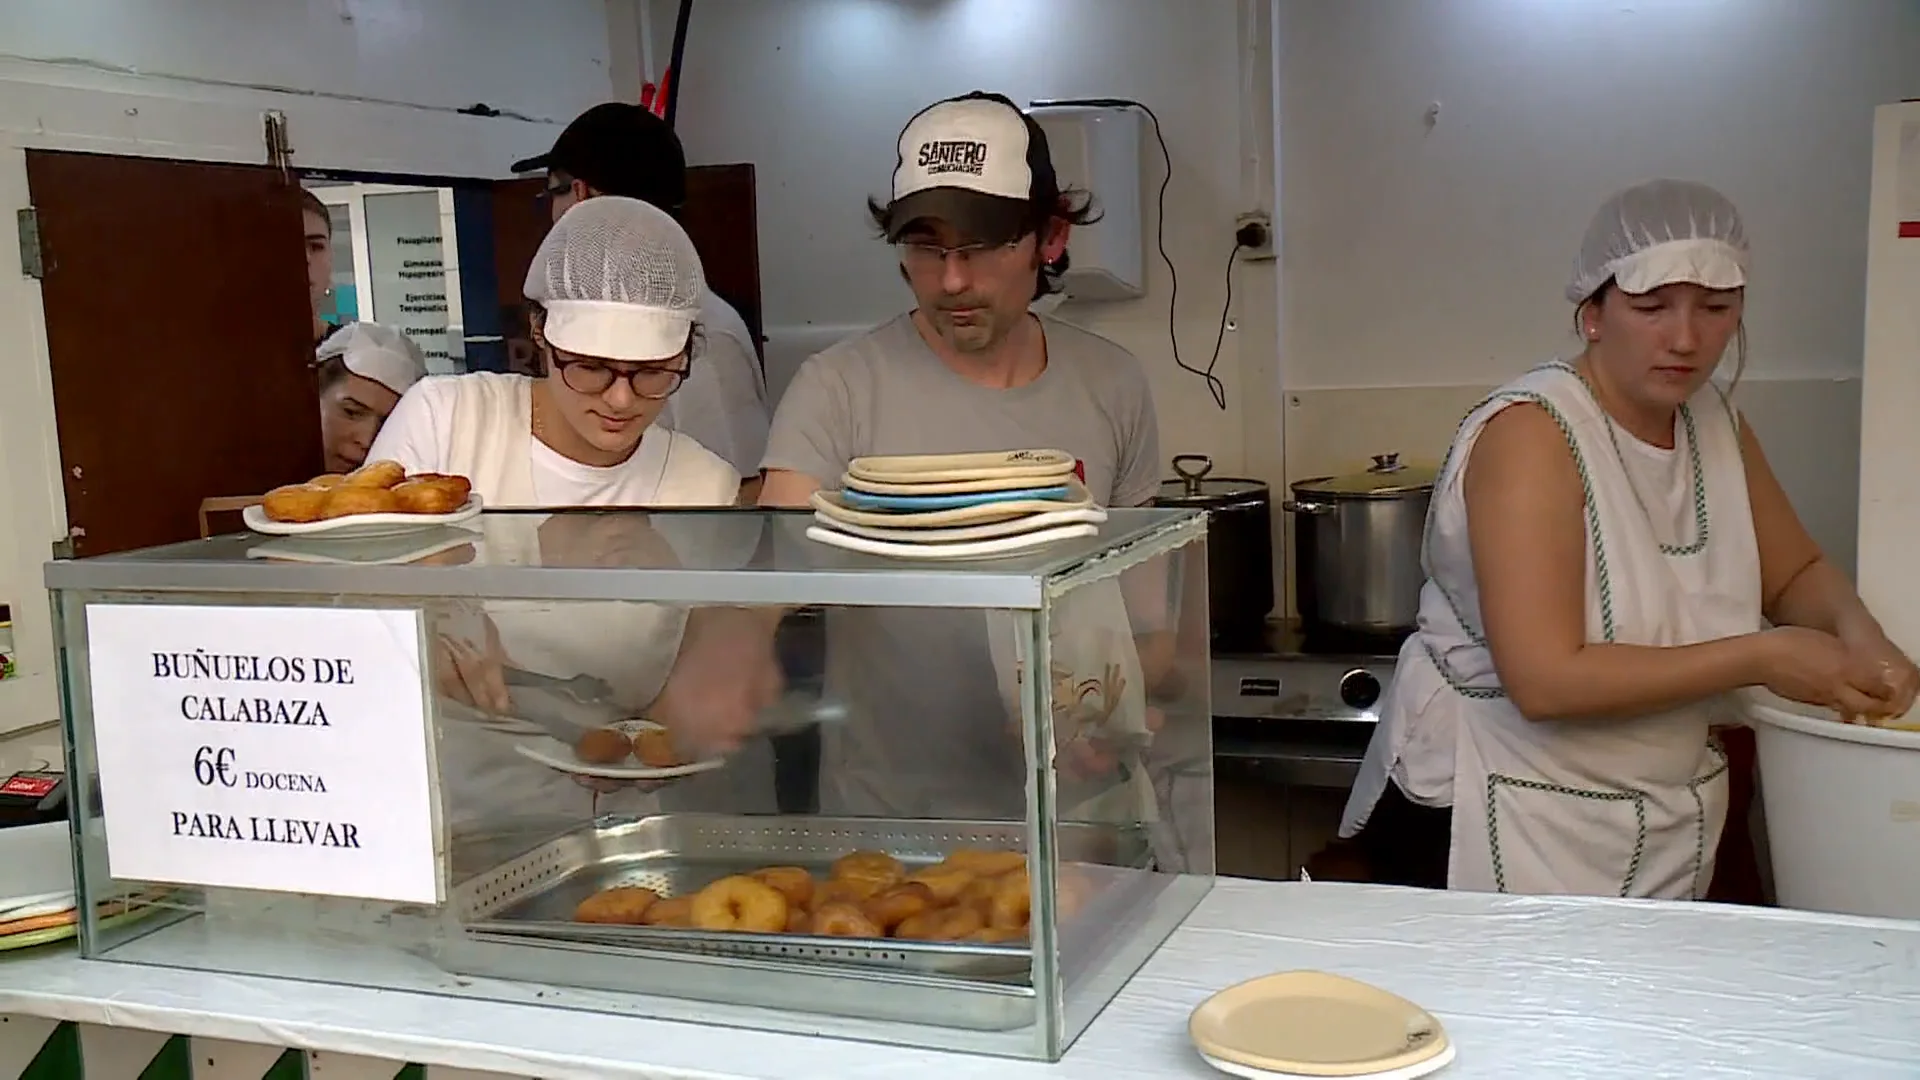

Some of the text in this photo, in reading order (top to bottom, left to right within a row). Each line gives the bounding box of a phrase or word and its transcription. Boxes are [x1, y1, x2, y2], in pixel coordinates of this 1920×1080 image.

[918, 141, 987, 167] SANTERO
[398, 271, 445, 279] Hipopresiv
[403, 260, 443, 269] Gimnasia
[152, 648, 354, 684] BUÑUELOS DE
[181, 695, 331, 727] CALABAZA
[194, 746, 327, 793] 6€ DOCENA
[171, 811, 361, 849] PARA LLEVAR
